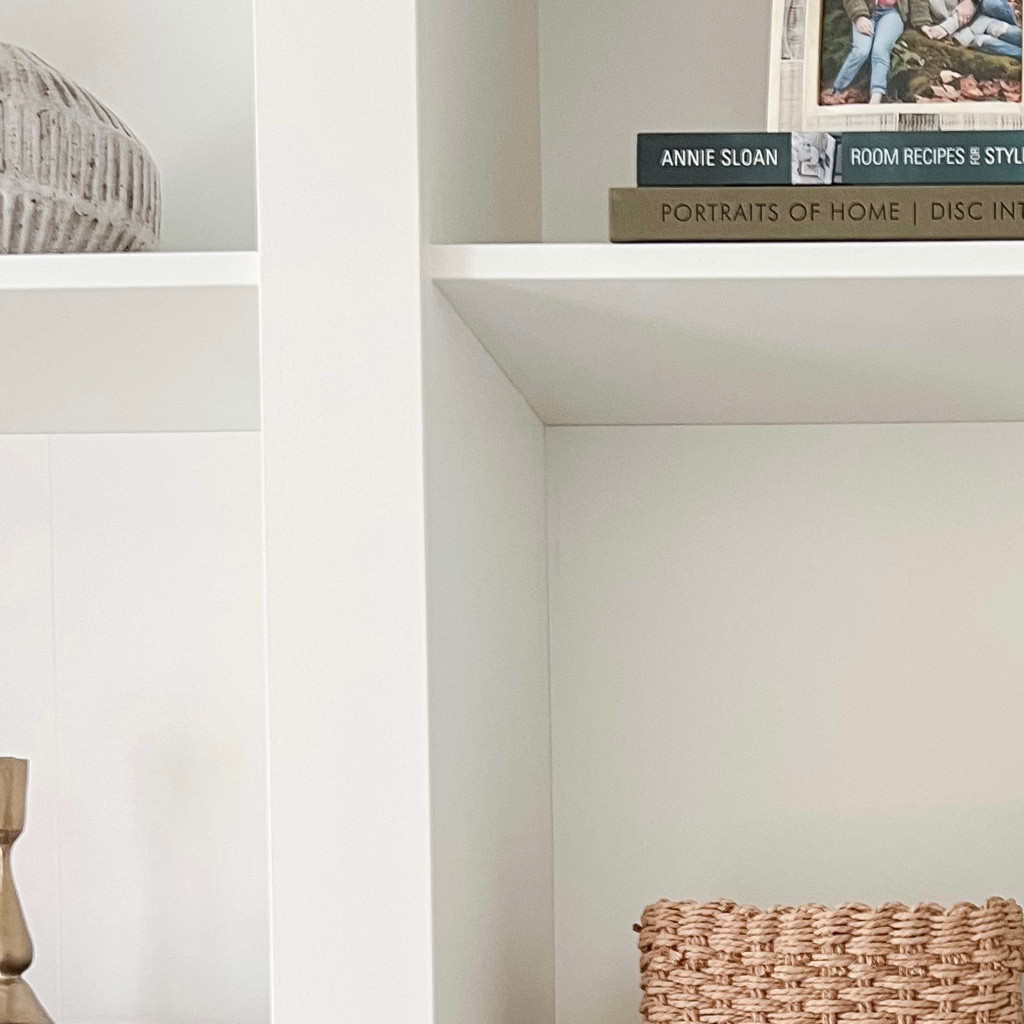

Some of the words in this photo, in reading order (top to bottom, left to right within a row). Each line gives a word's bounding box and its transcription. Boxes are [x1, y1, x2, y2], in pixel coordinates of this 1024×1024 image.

[661, 149, 715, 166] ANNIE
[721, 149, 778, 166] SLOAN
[851, 147, 899, 166] ROOM
[904, 147, 965, 165] RECIPES
[970, 146, 980, 165] FOR
[662, 203, 779, 222] PORTRAITS
[789, 203, 820, 221] OF
[831, 202, 900, 221] HOME
[931, 202, 983, 220] DISC
